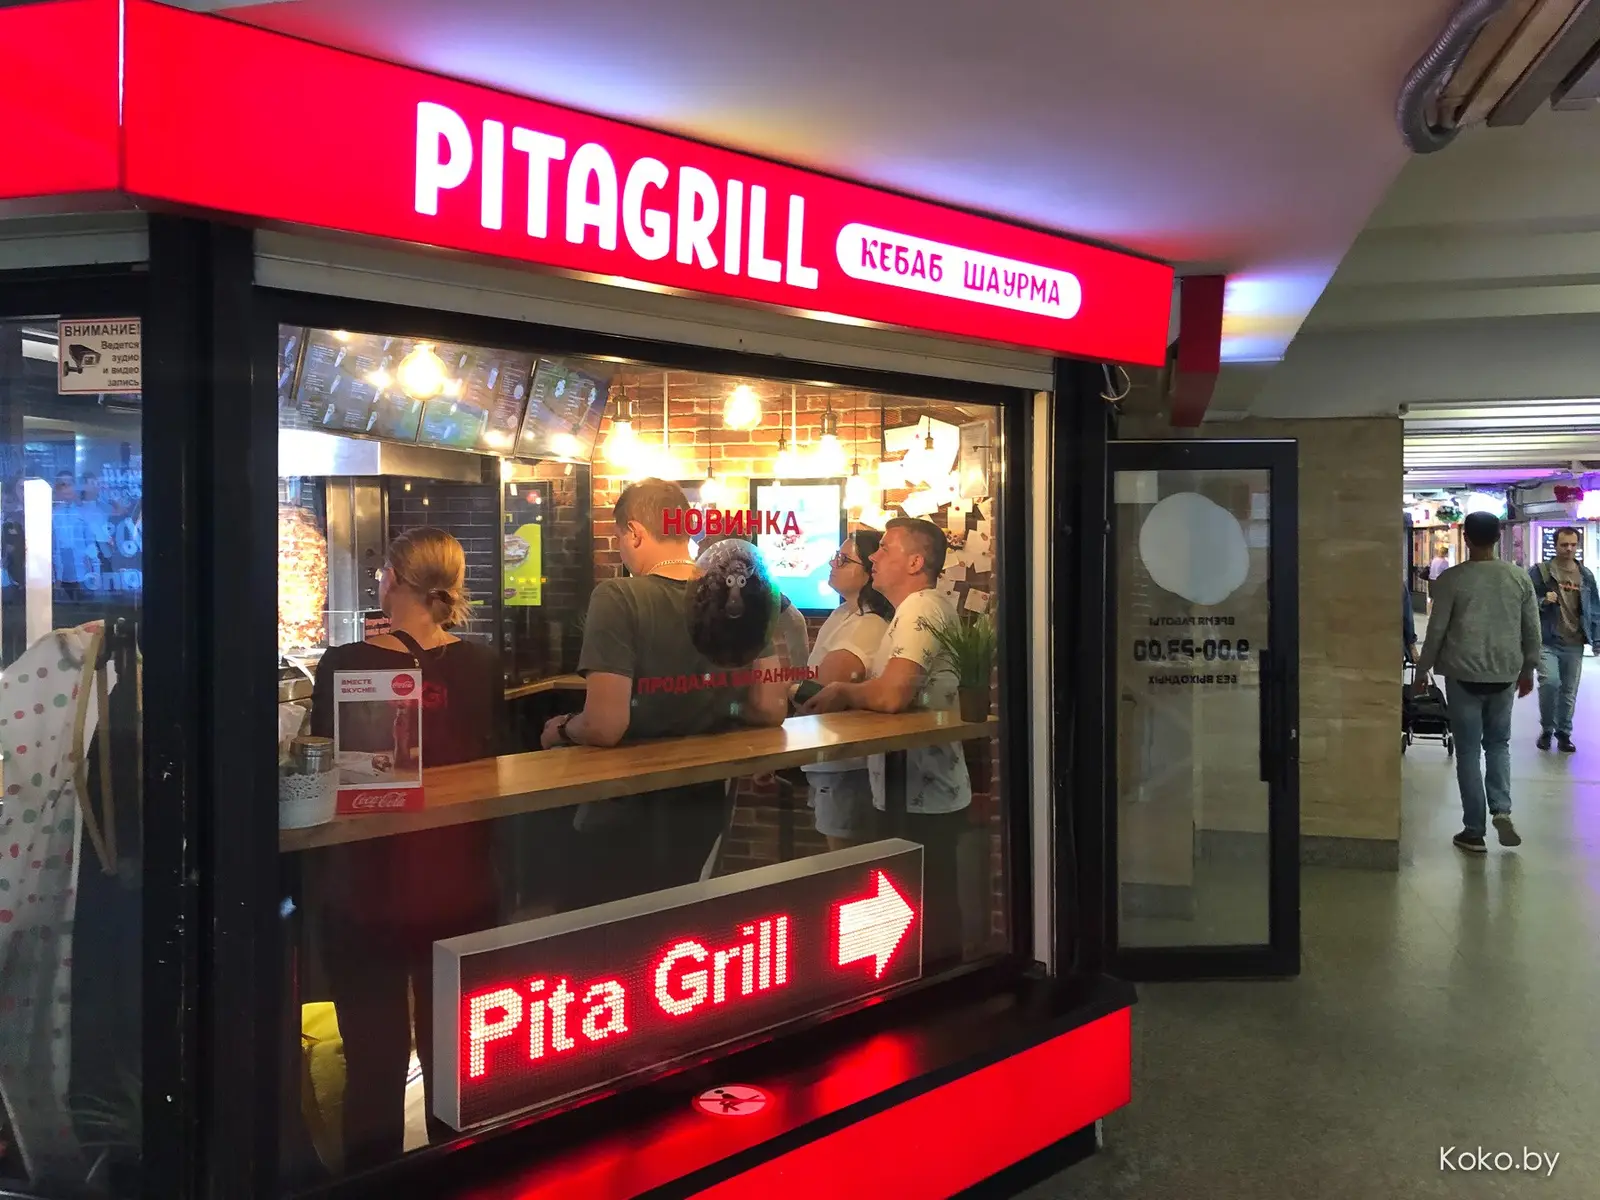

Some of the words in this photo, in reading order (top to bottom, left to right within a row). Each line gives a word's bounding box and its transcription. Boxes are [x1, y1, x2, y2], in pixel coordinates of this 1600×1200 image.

[414, 101, 819, 290] PITAGRILL
[860, 237, 943, 282] КЕБАБ
[963, 260, 1060, 306] ШАУРМА
[64, 324, 140, 336] ВНИМАНИЕ!
[101, 340, 139, 350] Ведется
[111, 354, 139, 363] аудио
[111, 366, 139, 375] видео
[107, 379, 139, 387] запись
[661, 508, 801, 535] НОВИНКА
[469, 978, 628, 1078] Pita
[654, 915, 788, 1016] Grill
